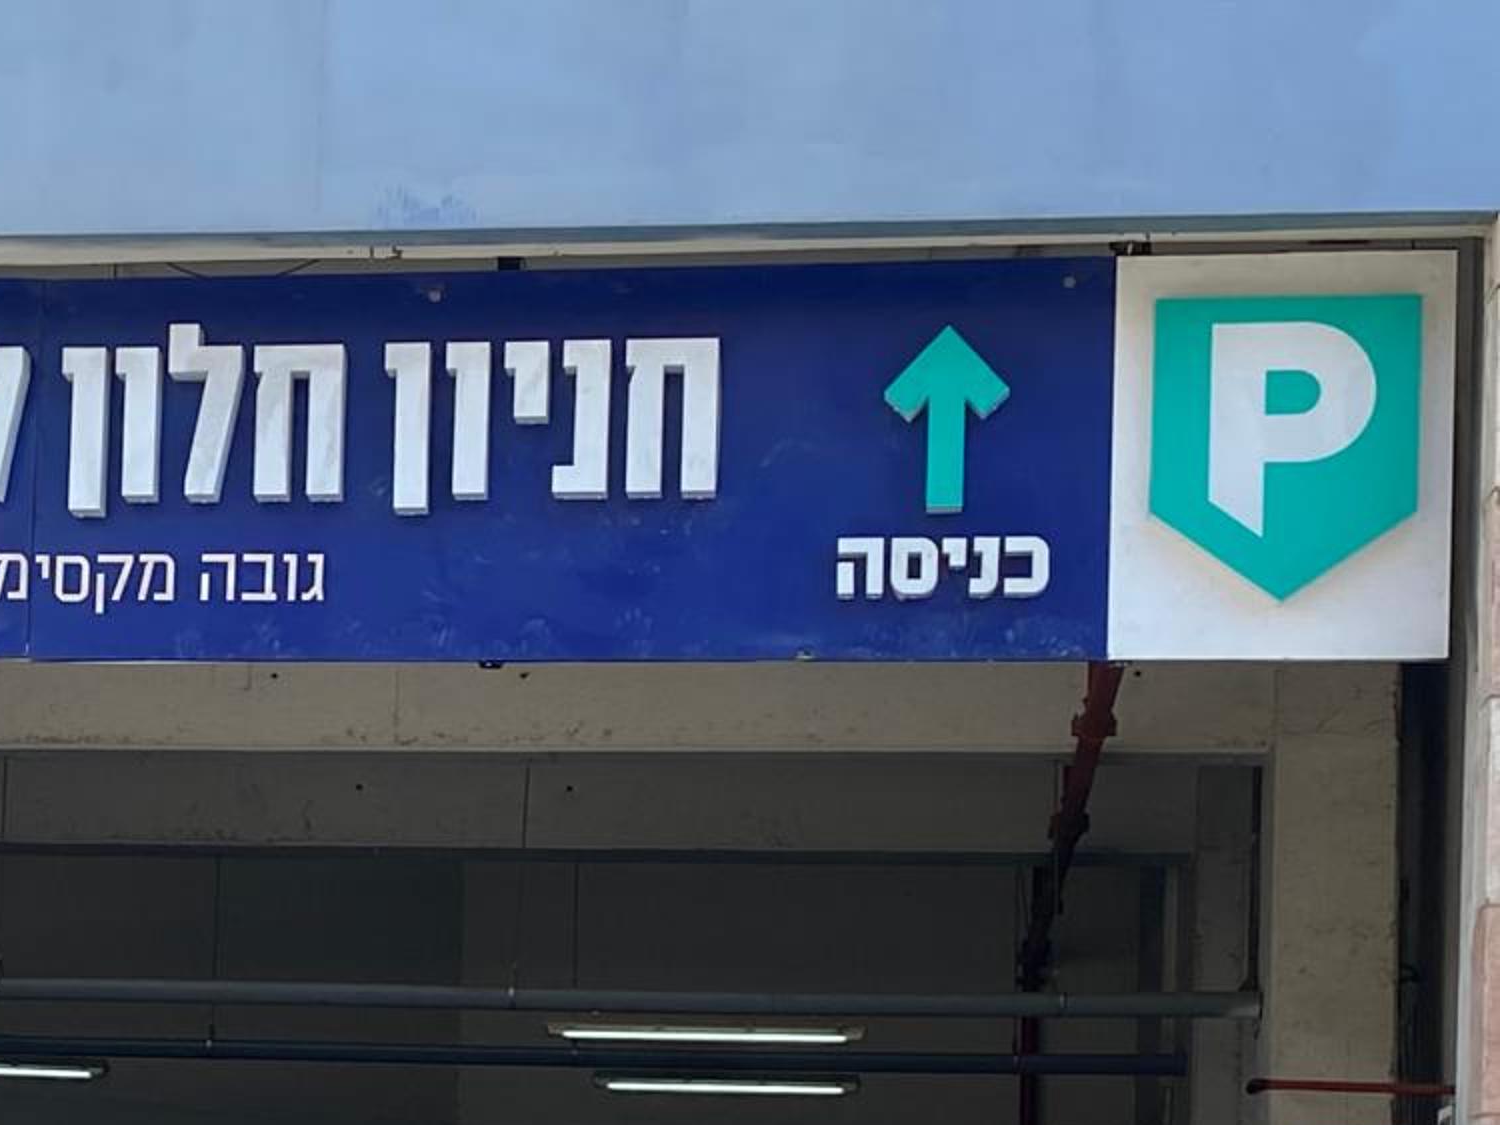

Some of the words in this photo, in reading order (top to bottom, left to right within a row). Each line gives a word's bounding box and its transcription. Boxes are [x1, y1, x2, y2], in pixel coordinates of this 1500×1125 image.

[61, 322, 348, 518] חלון
[384, 336, 721, 516] חניון
[1207, 320, 1377, 538] P
[198, 552, 326, 602] גובה
[835, 534, 1051, 599] כניסה
